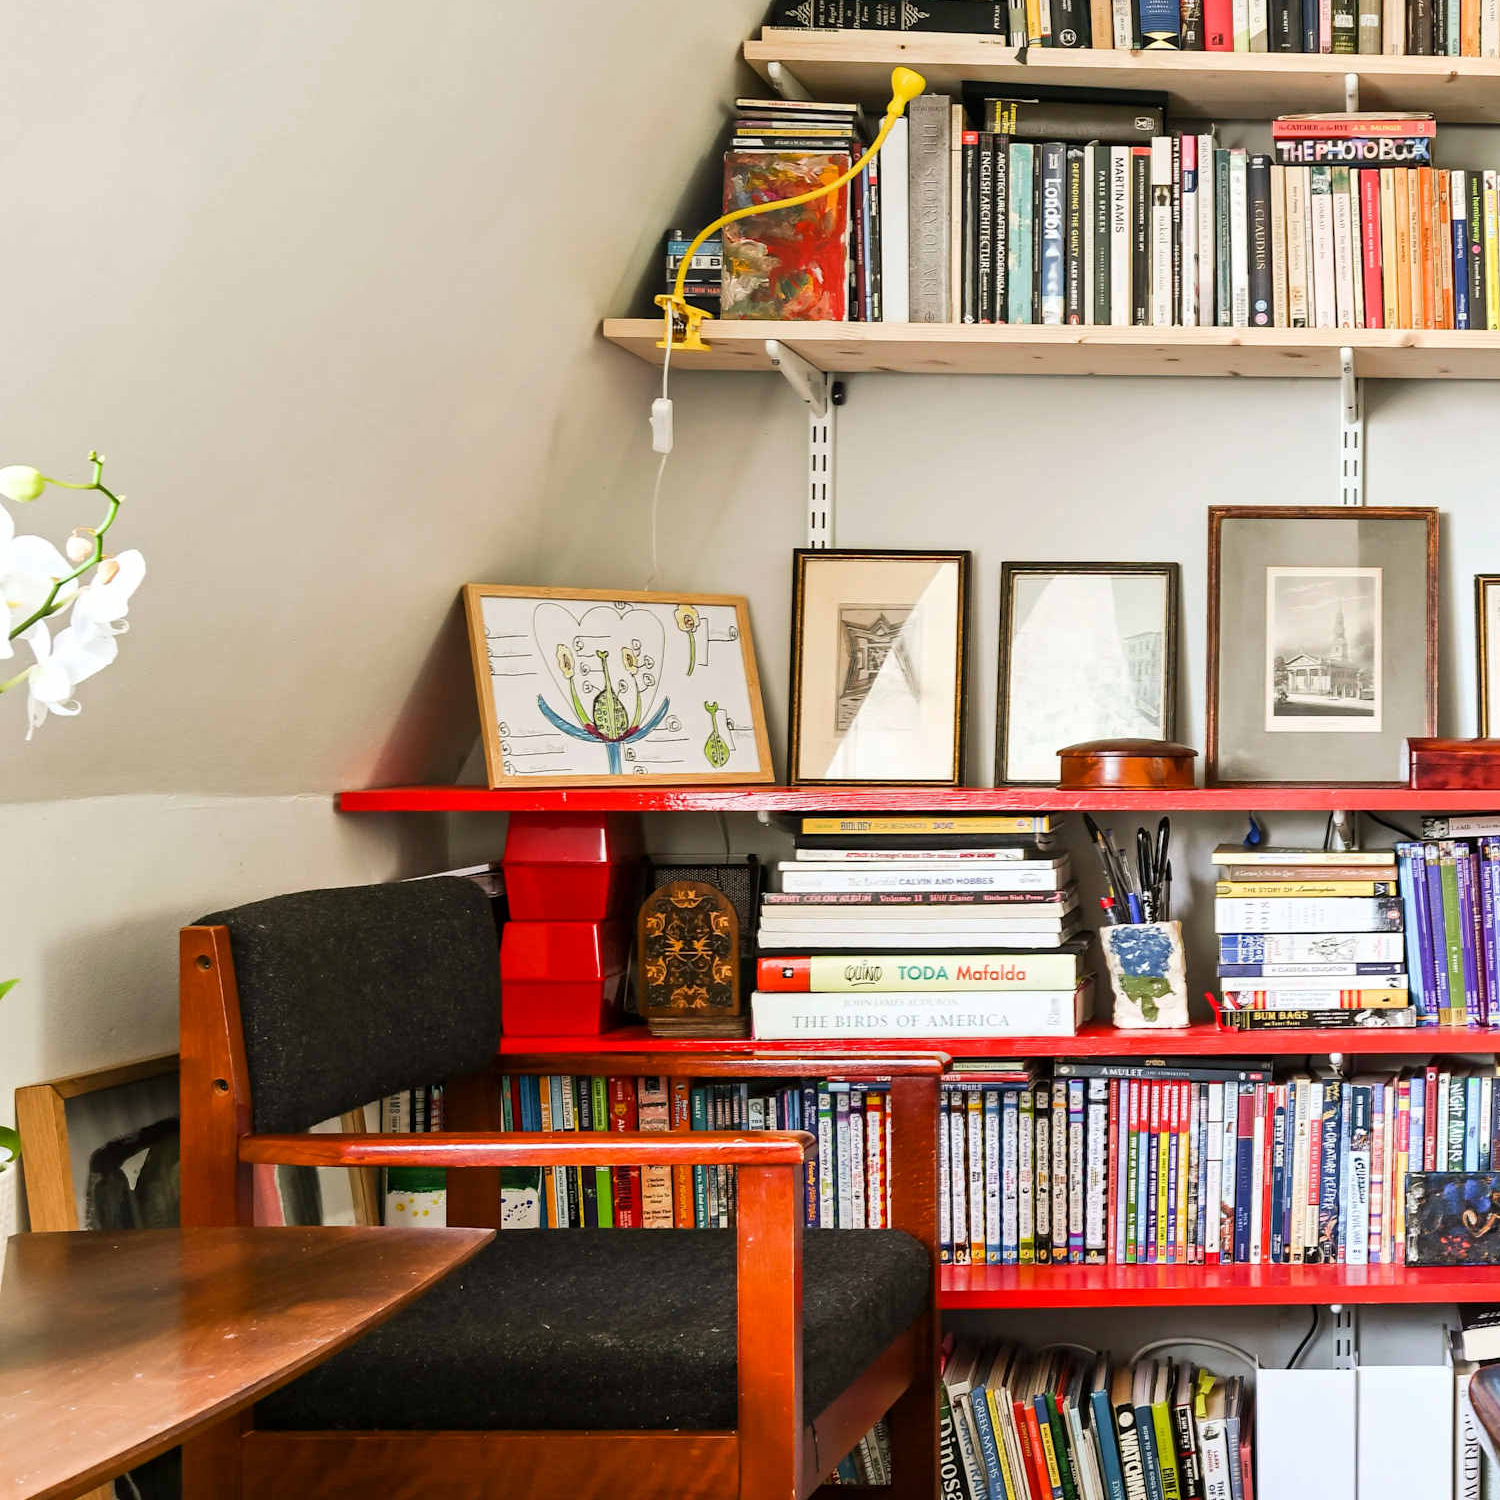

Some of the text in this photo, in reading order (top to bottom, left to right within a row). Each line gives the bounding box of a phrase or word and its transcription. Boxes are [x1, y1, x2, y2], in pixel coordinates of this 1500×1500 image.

[922, 123, 936, 156] THE
[923, 167, 936, 230] STORY
[1044, 178, 1062, 239] London
[1115, 157, 1125, 233] MARTIN AMIS
[980, 151, 991, 273] ENGLISH ARCHITECTURE
[996, 152, 1005, 293] ARCHITECTURE AFTER MODERNISM
[1071, 212, 1079, 227] THE
[1071, 230, 1079, 257] GUILTY
[1159, 215, 1169, 244] naked
[924, 267, 937, 303] ART
[898, 964, 1026, 981] TODA Mafalda
[792, 1014, 1010, 1029] THE BIRDS OF AMERICA
[1253, 1010, 1308, 1020] BUM BAGS
[1100, 1067, 1143, 1077] AMULET
[1449, 1083, 1465, 1162] NIGHT RAIDERS
[1163, 1467, 1180, 1495] CRIME
[1209, 1484, 1217, 1495] OF
[1216, 1481, 1226, 1495] THE
